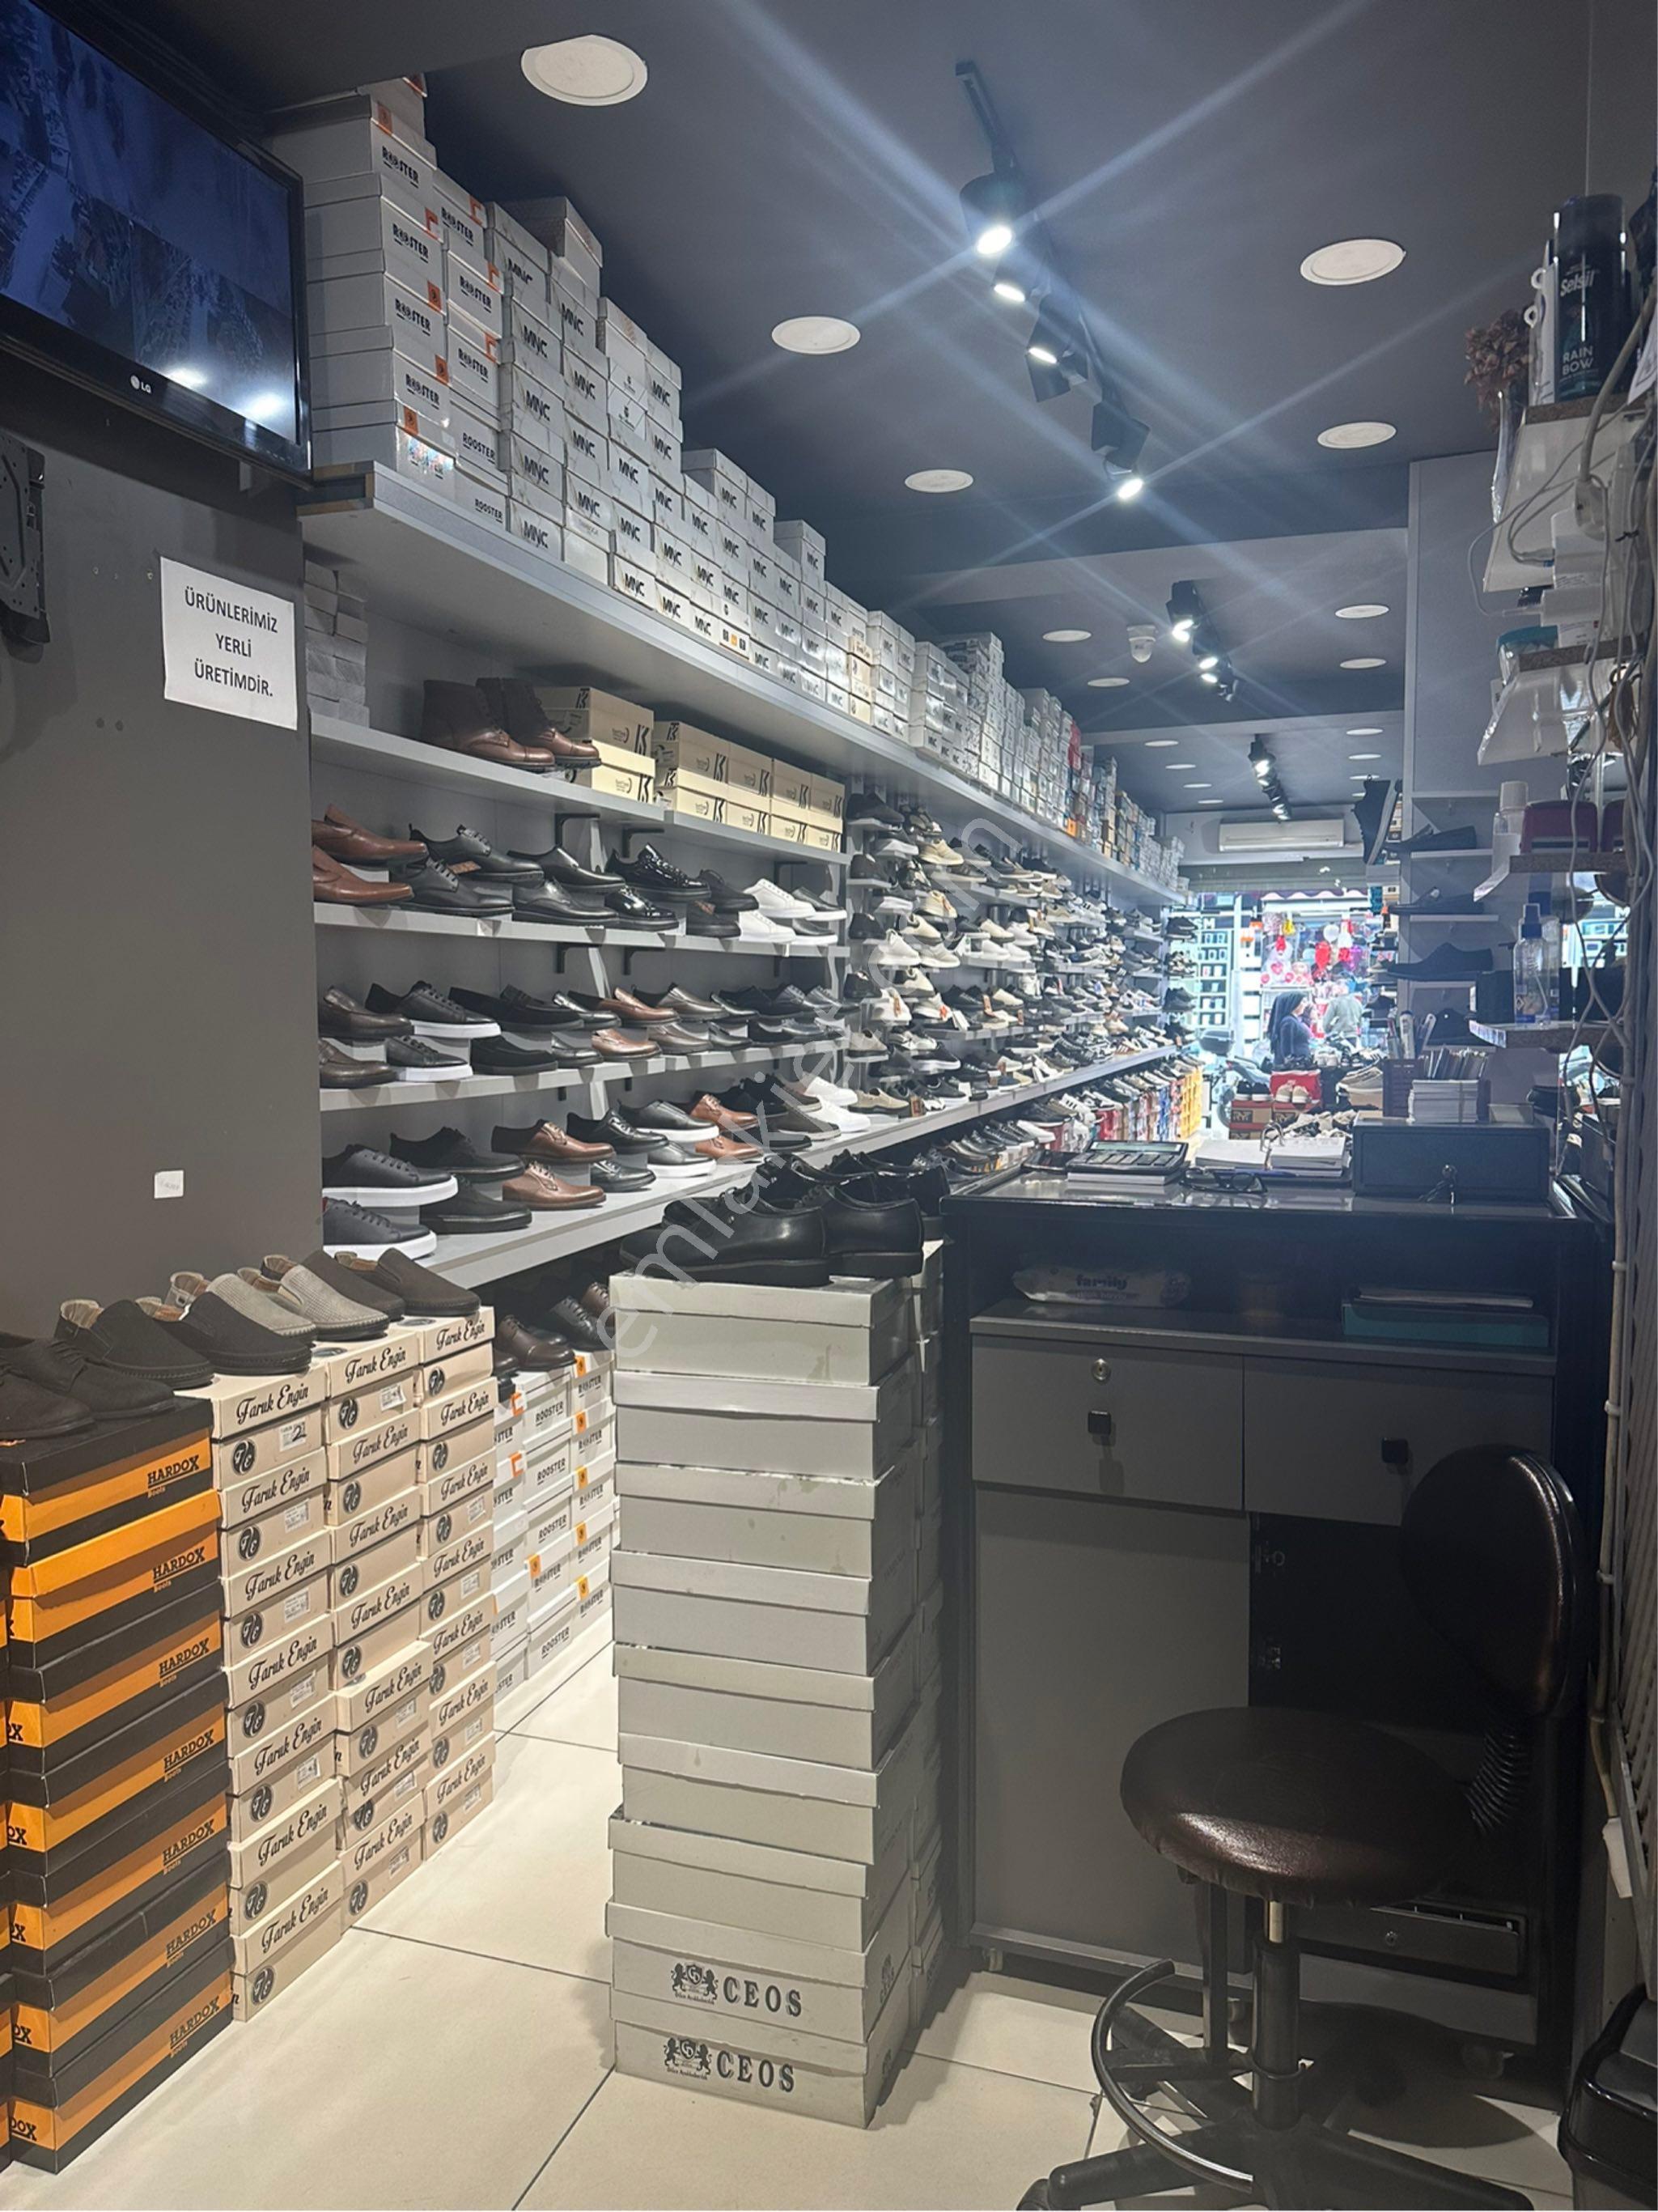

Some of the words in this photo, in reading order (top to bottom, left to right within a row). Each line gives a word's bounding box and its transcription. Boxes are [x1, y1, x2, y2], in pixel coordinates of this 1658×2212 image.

[1563, 346, 1593, 363] RAIN
[1563, 358, 1594, 376] BOW
[463, 432, 496, 461] ROOSTER
[474, 499, 503, 520] ROOSTER
[184, 586, 278, 633] ÜRÜNLERİMİZ
[215, 633, 252, 657] YERLİ
[194, 658, 274, 697] ÜRETİMDİR.
[1076, 1274, 1129, 1290] family
[236, 1393, 274, 1424] Faruk
[278, 1383, 309, 1410] Engin
[536, 1401, 563, 1422] ROOSTER
[292, 1424, 307, 1441] 2
[147, 1455, 199, 1485] HARDOX
[537, 1458, 566, 1481] ROOSTER
[242, 1480, 278, 1513] Faruk
[280, 1467, 310, 1495] Engin
[538, 1514, 566, 1539] ROOSTER
[153, 1546, 205, 1581] HARDOX
[245, 1565, 281, 1601] Faruk
[285, 1552, 315, 1580] Engin
[159, 1637, 210, 1675] HARDOX
[541, 1627, 570, 1655] ROOSTER
[248, 1654, 284, 1690] Faruk
[287, 1637, 317, 1666] Engin
[163, 1729, 214, 1769] HARDOX
[255, 1736, 290, 1776] Faruk
[293, 1717, 322, 1750] Engin
[162, 1819, 214, 1863] HARDOX
[258, 1824, 295, 1866] Faruk
[297, 1804, 327, 1838] Engin
[166, 1908, 216, 1956] HARDOX
[261, 1910, 296, 1954] Faruk
[299, 1887, 329, 1923] Engin
[723, 1976, 802, 2017] CEOS
[169, 1995, 219, 2048] HARDOX
[717, 2050, 795, 2092] CEOS
